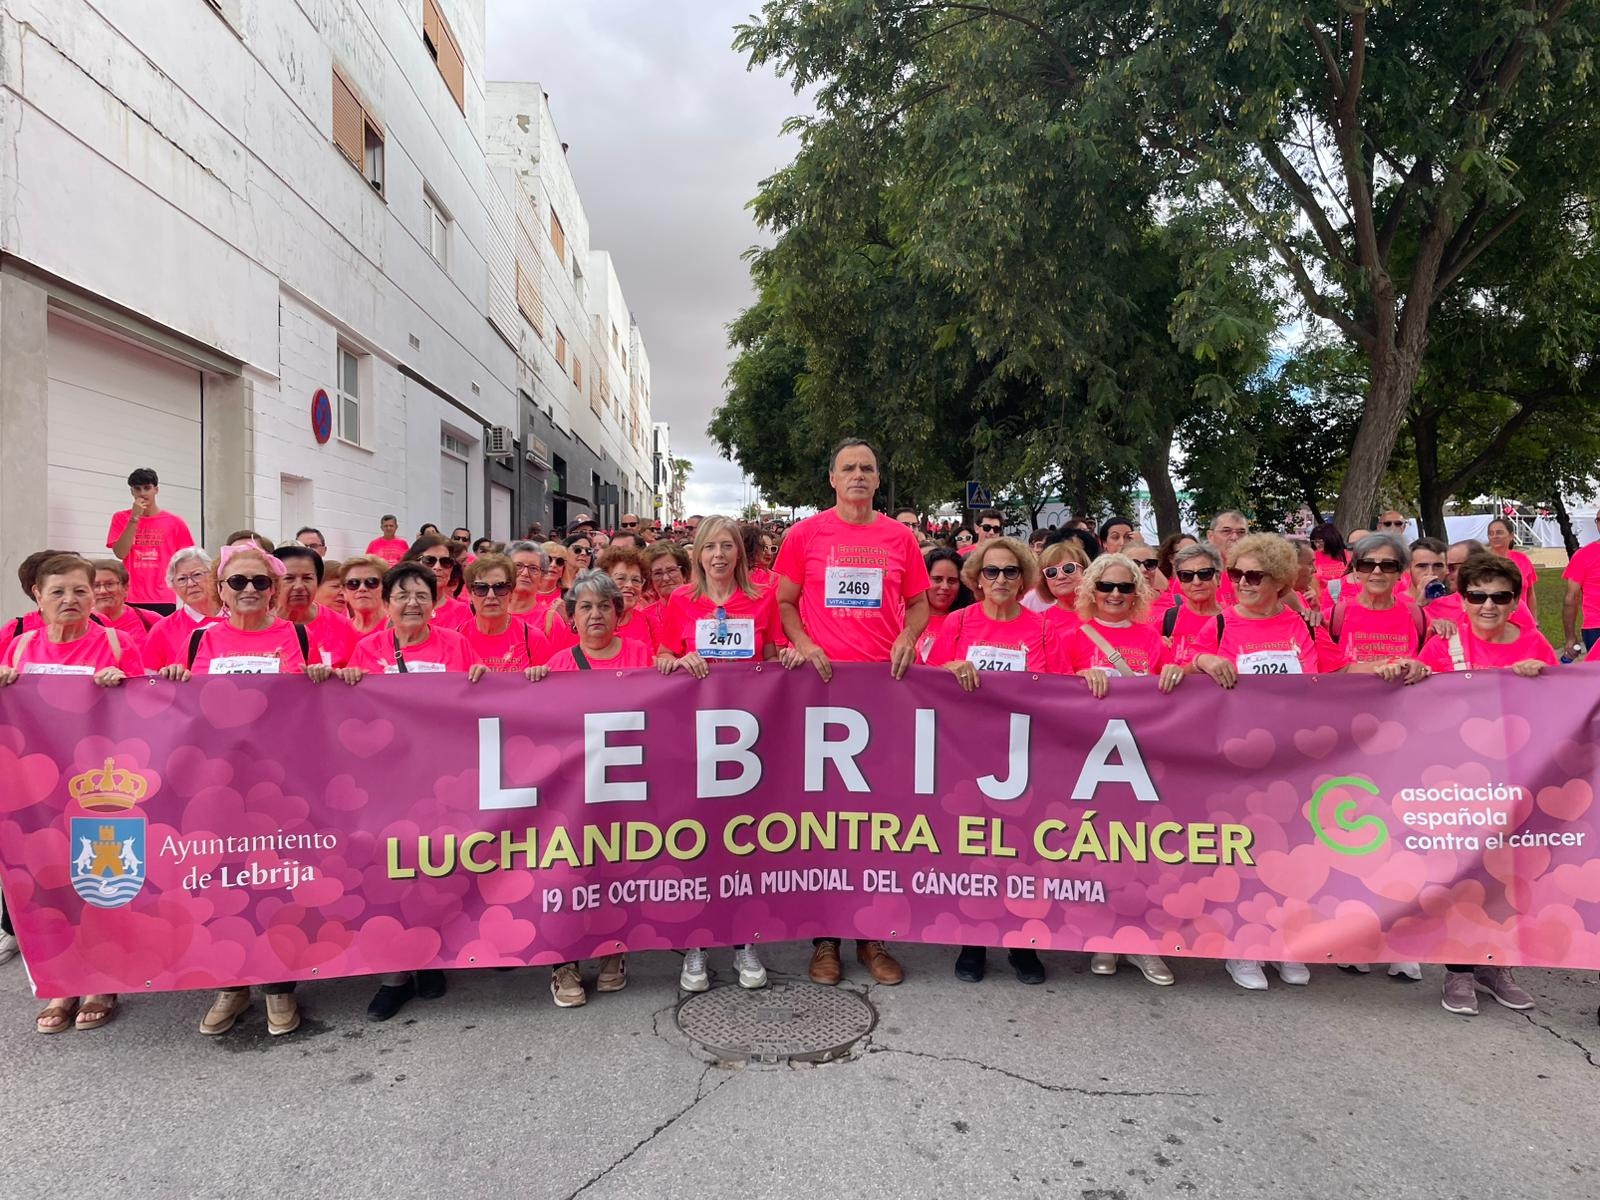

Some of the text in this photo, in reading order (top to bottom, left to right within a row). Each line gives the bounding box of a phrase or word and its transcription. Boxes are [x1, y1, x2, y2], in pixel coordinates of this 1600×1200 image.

[838, 580, 870, 595] 2469
[709, 632, 742, 646] 2470
[979, 659, 1012, 671] 2474
[1252, 662, 1289, 675] 2024
[477, 706, 1160, 811] LEBRIJA
[1400, 783, 1523, 801] asociación
[1402, 807, 1508, 829] española
[159, 828, 338, 865] Ayuntamiento
[386, 810, 1256, 880] LUCHANDO CONTRA EL CÁNCER
[1405, 829, 1586, 850] contra el cáncer
[182, 860, 316, 891] de Lebrija
[542, 867, 1106, 913] 19 DE OCTUBRE, DÍA MUNDIAL DEL CÁNCER DE MAMA
